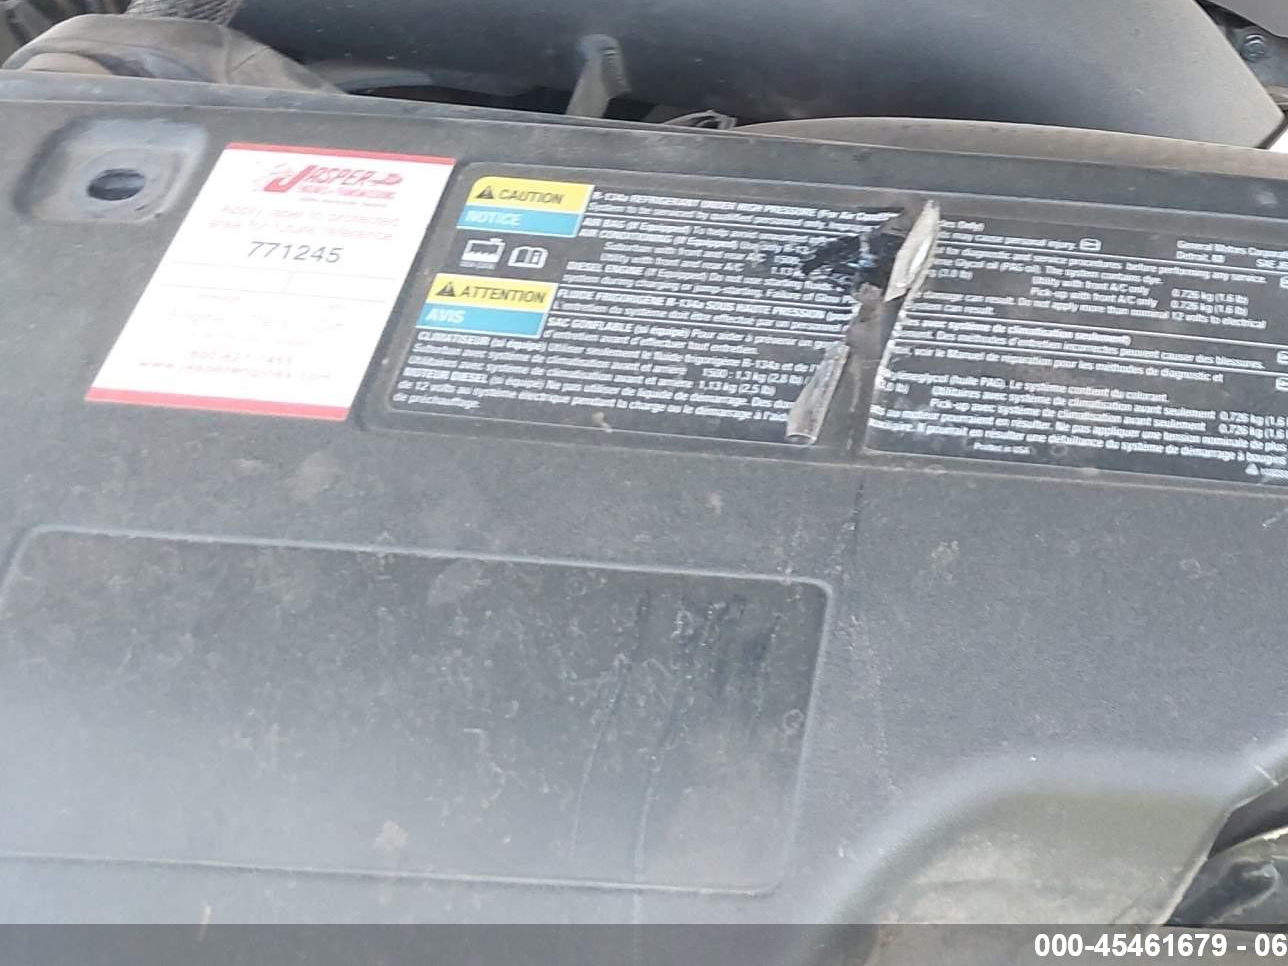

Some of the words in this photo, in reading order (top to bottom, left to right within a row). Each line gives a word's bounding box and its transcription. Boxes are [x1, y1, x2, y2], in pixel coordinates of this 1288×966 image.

[263, 164, 377, 193] JASPER
[499, 188, 564, 204] CAUTION
[464, 209, 523, 226] NOTICE
[248, 240, 345, 264] 771245
[461, 285, 547, 304] ATTENTION
[424, 307, 467, 324] AVIS
